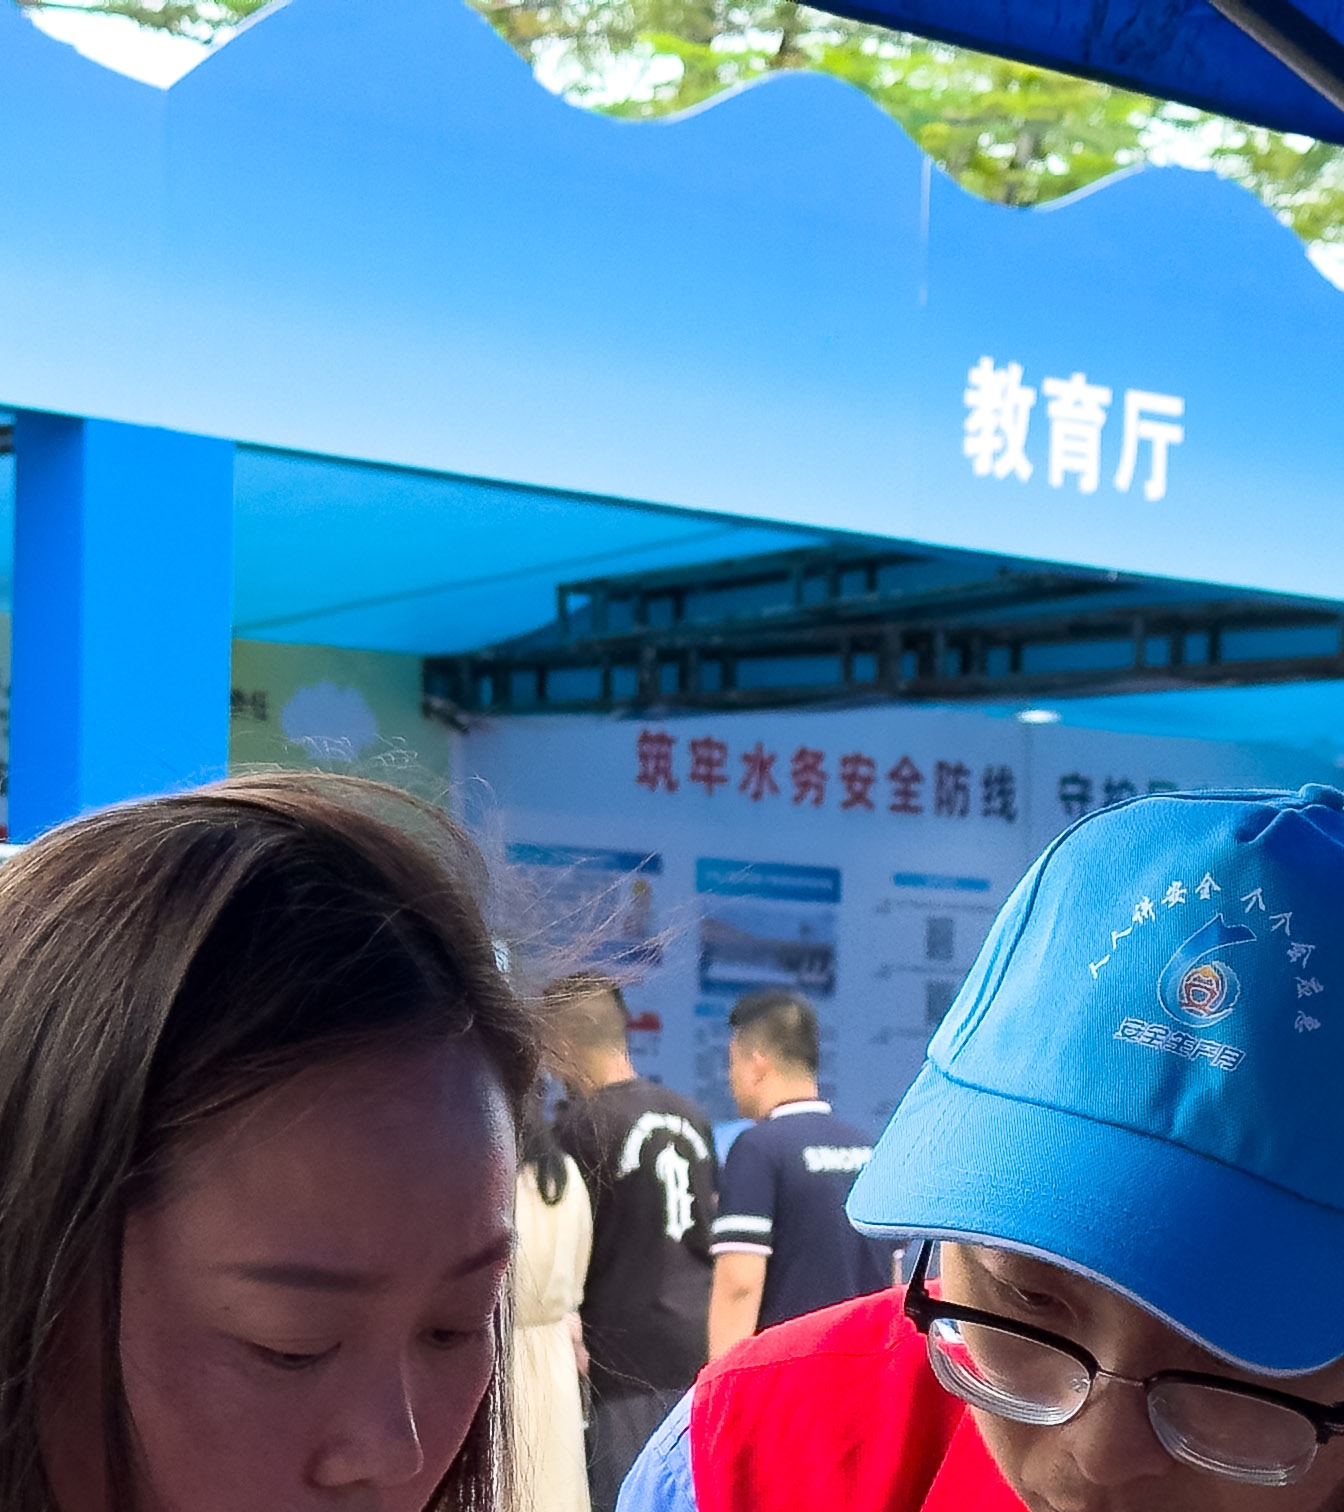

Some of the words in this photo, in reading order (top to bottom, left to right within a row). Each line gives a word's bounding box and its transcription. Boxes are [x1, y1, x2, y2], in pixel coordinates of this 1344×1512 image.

[962, 355, 1186, 501] 教育厅
[635, 729, 1019, 824] 筑牢水务安全防线
[1112, 1015, 1247, 1072] 安全生产月
